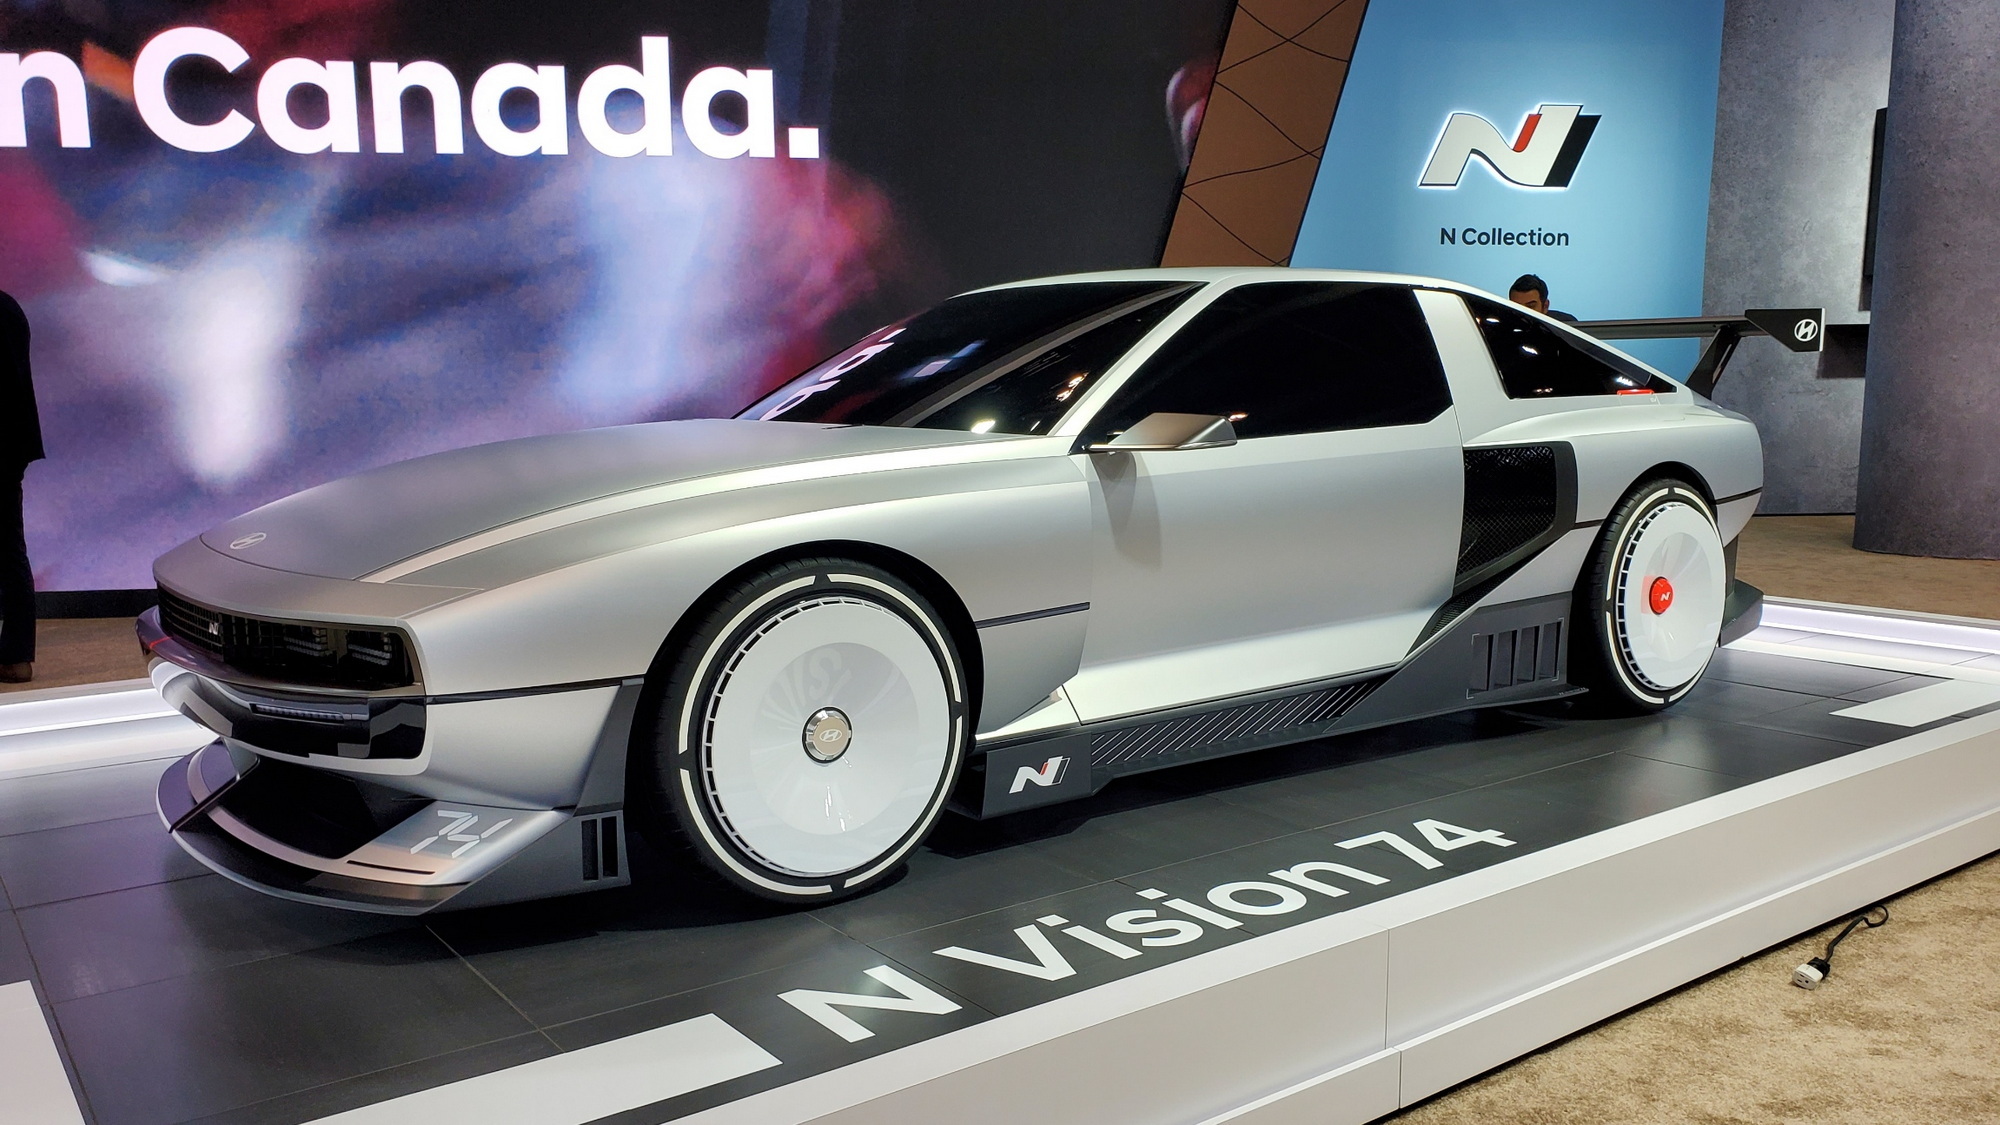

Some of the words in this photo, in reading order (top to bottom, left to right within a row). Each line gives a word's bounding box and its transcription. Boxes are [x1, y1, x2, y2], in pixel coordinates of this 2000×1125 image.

[0, 51, 91, 148] n
[134, 28, 819, 159] Canada.
[1440, 228, 1456, 245] N
[1462, 228, 1569, 246] Collection
[410, 809, 514, 859] 74
[776, 964, 964, 1043] N
[932, 861, 1391, 982] Vision
[1333, 818, 1518, 870] 74
